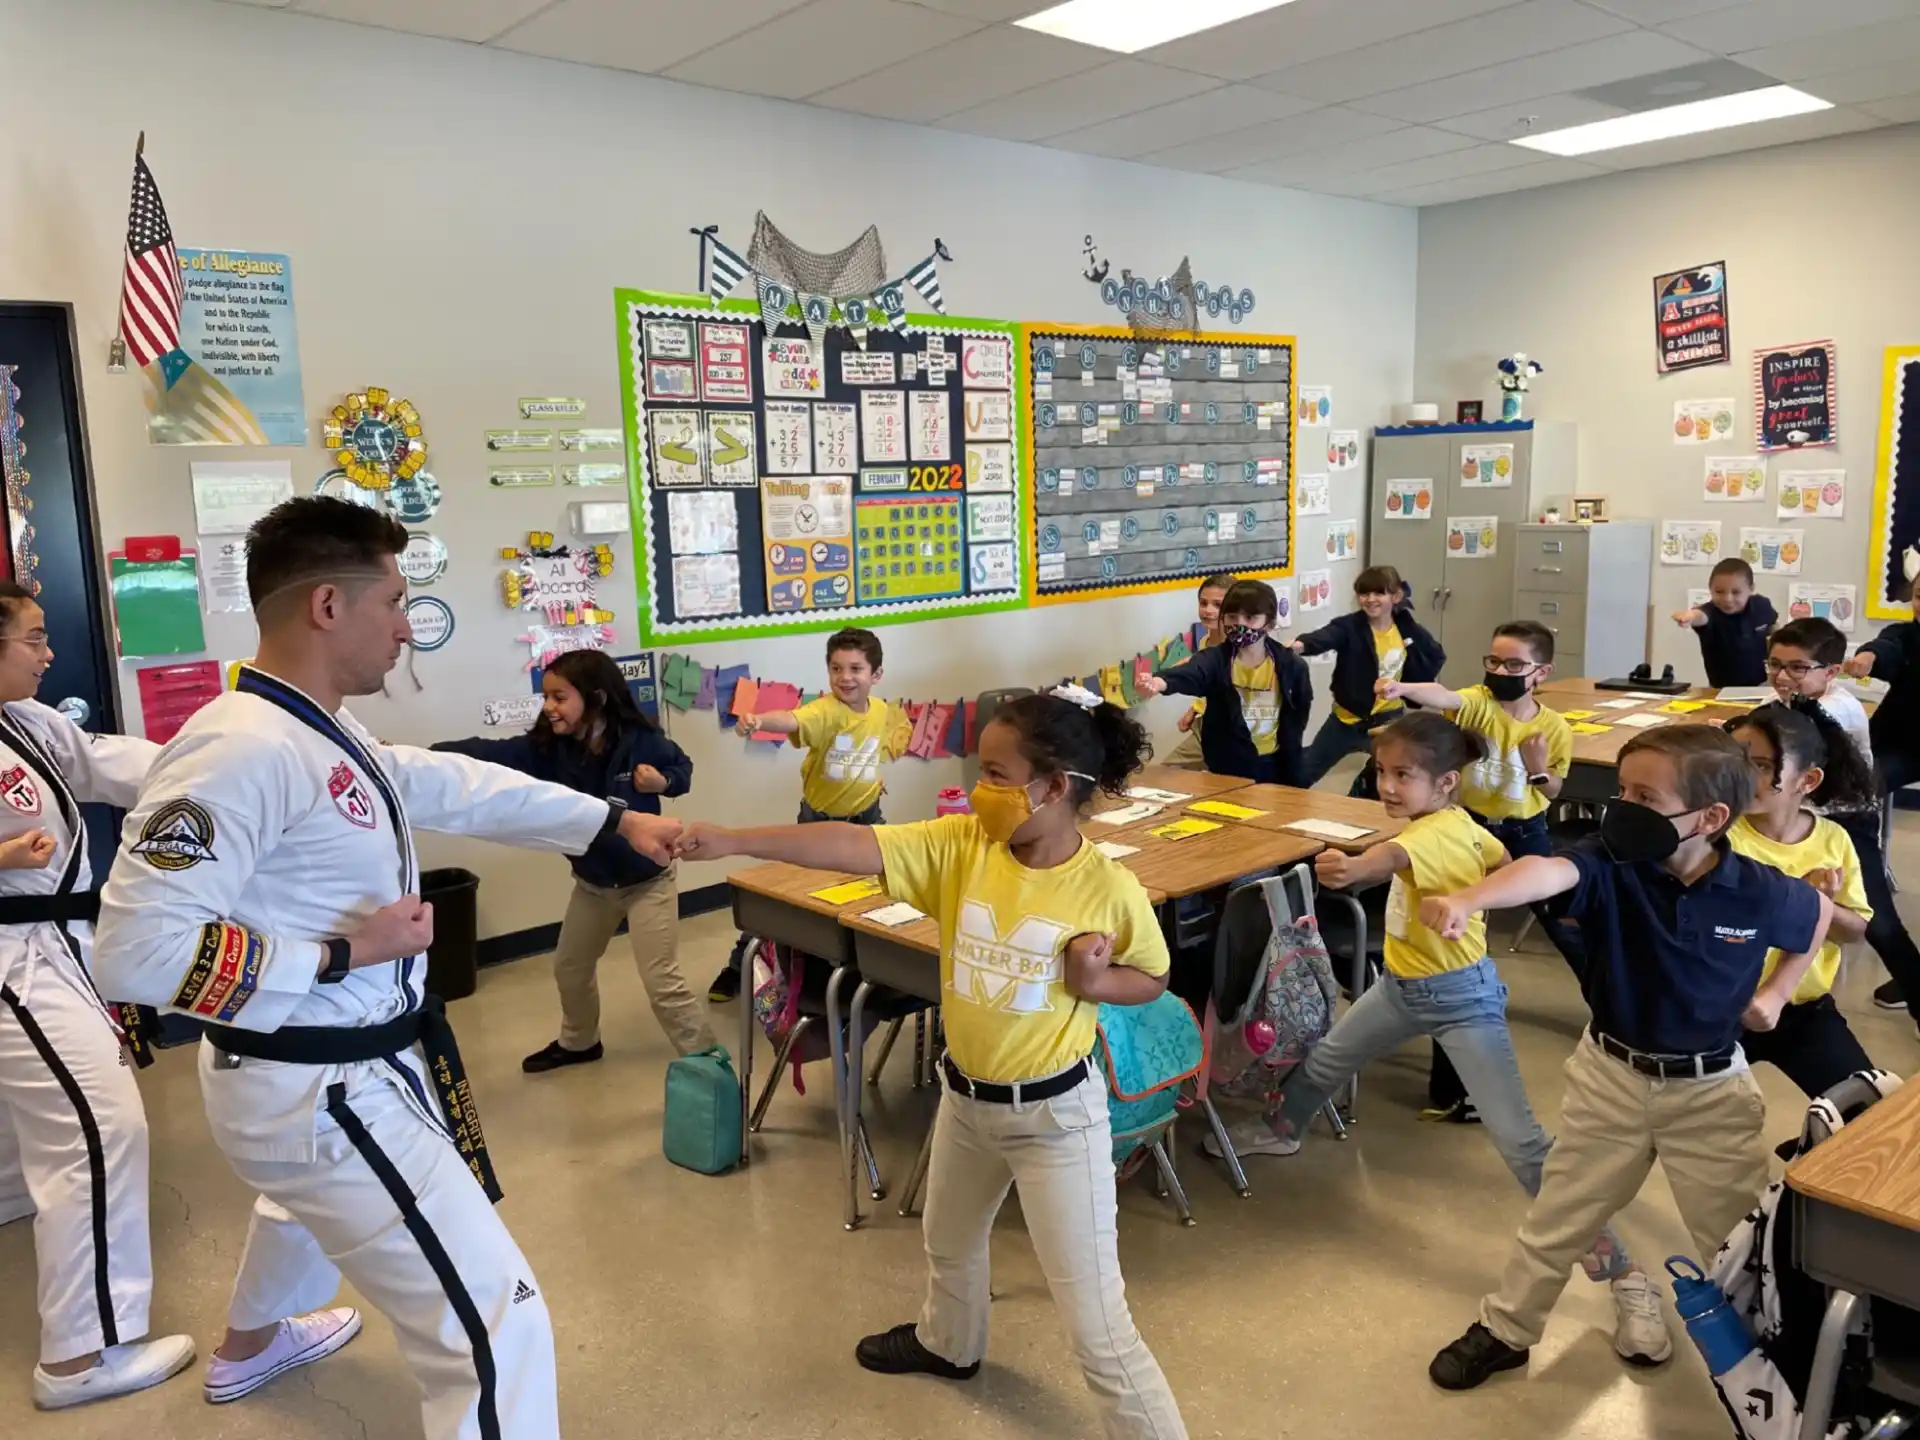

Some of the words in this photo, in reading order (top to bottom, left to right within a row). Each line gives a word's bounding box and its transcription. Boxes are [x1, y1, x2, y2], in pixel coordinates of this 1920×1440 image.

[191, 253, 207, 271] of
[211, 253, 284, 277] Allegiance
[188, 278, 212, 289] pledge
[213, 279, 248, 291] allegiance
[249, 281, 257, 290] to
[259, 281, 270, 291] the
[271, 282, 285, 293] flag
[190, 292, 203, 301] the
[203, 293, 226, 303] United
[227, 294, 249, 304] States
[259, 296, 288, 306] America
[1196, 287, 1251, 321] WORDS
[204, 308, 217, 317] and
[219, 308, 227, 317] to
[228, 308, 239, 318] the
[241, 309, 271, 320] Republic
[1663, 302, 1681, 322] A
[1683, 303, 1720, 318] SEA
[205, 322, 215, 332] for
[217, 322, 238, 332] which
[201, 338, 214, 346] one
[215, 336, 239, 346] Nation
[240, 337, 260, 347] under
[240, 352, 257, 361] with
[257, 352, 280, 363] liberty
[1039, 353, 1052, 367] Aa
[1084, 349, 1097, 363] Bb
[1125, 350, 1136, 365] Cc
[1768, 356, 1821, 374] INSPIRE
[213, 366, 226, 375] and
[228, 366, 250, 376] justice
[252, 366, 262, 375] for
[1768, 400, 1780, 410] by
[1782, 394, 1825, 408] becoming
[1768, 406, 1809, 428] great
[1776, 416, 1826, 432] yourself.
[868, 473, 901, 485] FEBRUARY
[909, 464, 964, 492] 2022
[765, 480, 811, 501] Telling
[550, 563, 566, 577] All
[531, 579, 587, 596] Aboard
[145, 841, 203, 856] LEGACY
[182, 970, 208, 1001] LEVEL
[200, 958, 212, 969] 3
[204, 976, 230, 1007] LEVEL
[455, 1079, 486, 1150] INTEGRITY
[513, 1288, 537, 1305] adidas
